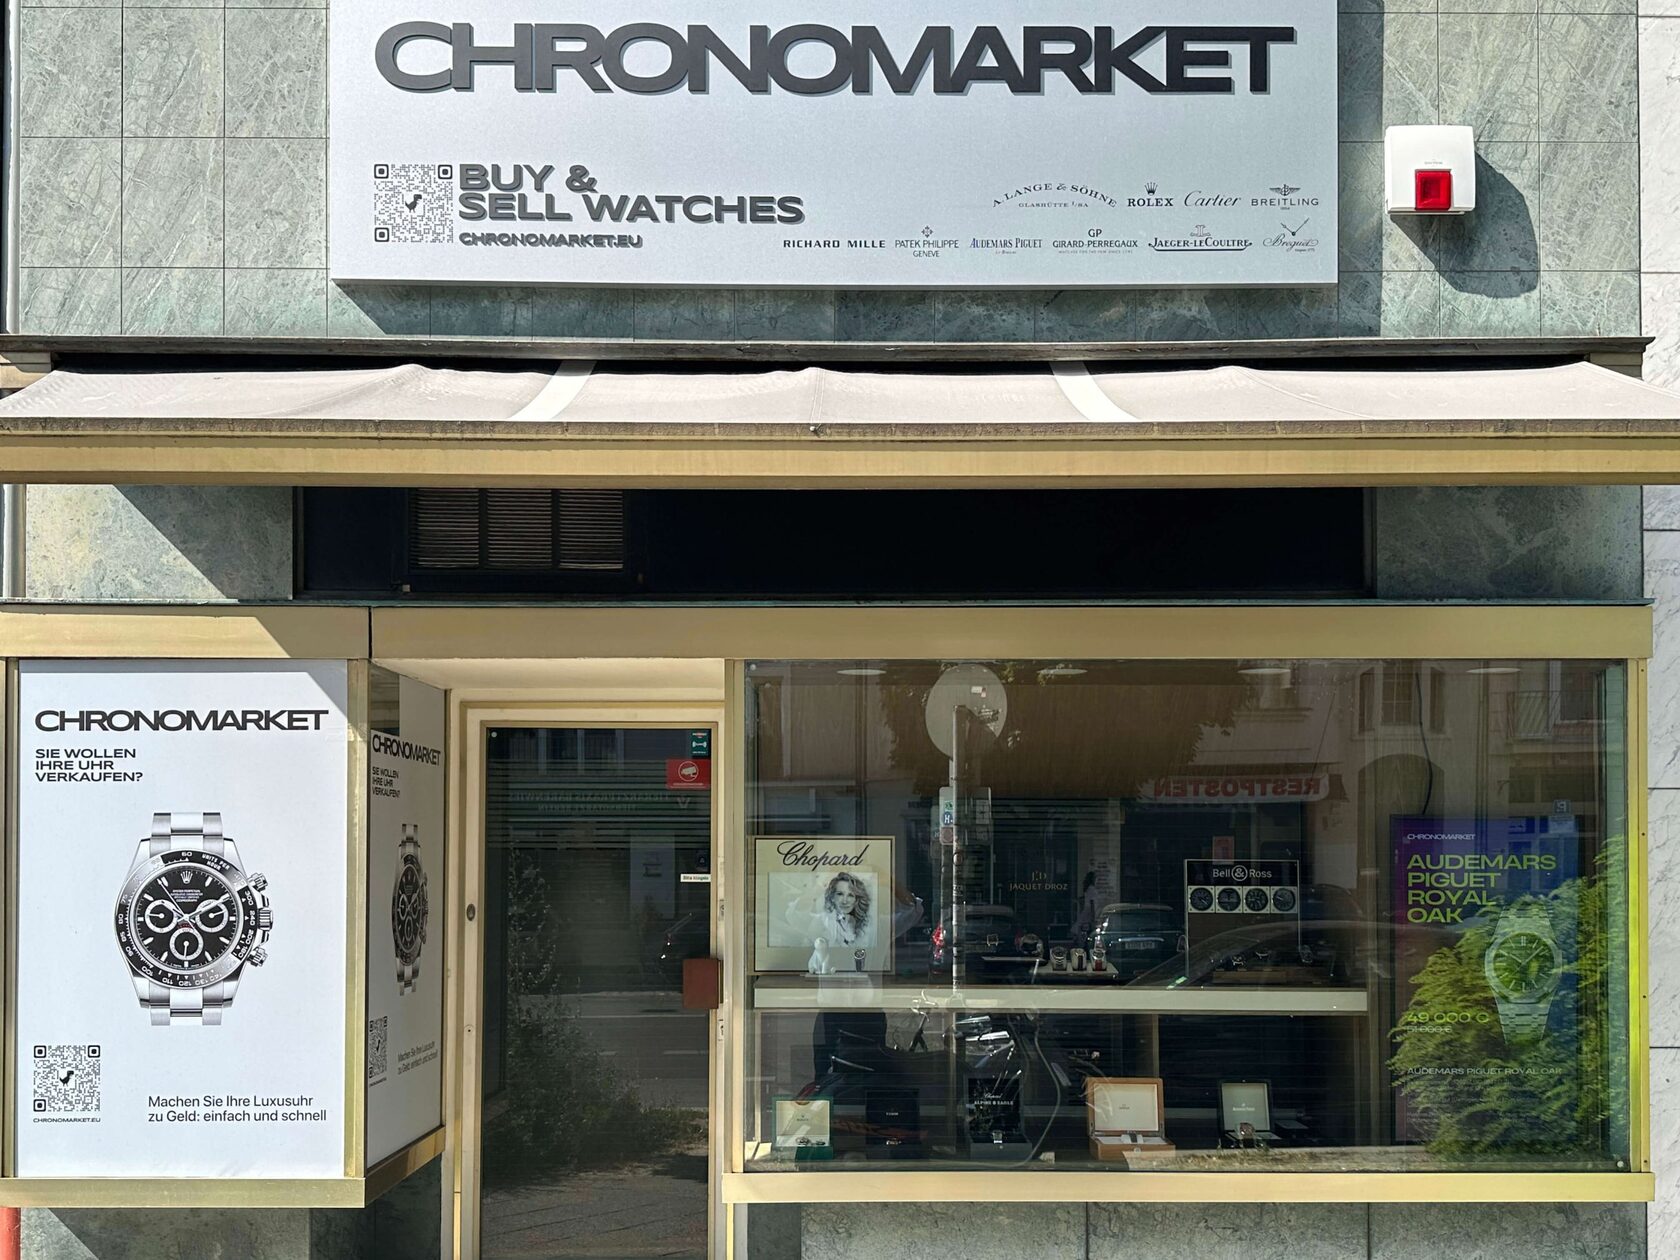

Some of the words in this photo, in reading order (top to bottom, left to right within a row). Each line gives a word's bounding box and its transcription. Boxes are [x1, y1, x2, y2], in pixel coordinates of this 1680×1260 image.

[375, 21, 1296, 94] CHRONOMARKET
[459, 163, 555, 192] BUY
[565, 164, 598, 193] &
[1004, 183, 1053, 200] LANGE
[1057, 183, 1067, 191] &
[1070, 184, 1117, 208] SÖHNE
[1127, 198, 1174, 207] ROLEX
[1184, 190, 1242, 207] Cartier
[1251, 198, 1320, 207] BREITLING
[459, 193, 573, 222] SELL
[582, 194, 806, 224] WATCHES
[459, 233, 643, 248] CHRONOMARKET.EU
[1088, 229, 1103, 238] GP
[783, 240, 840, 248] RICHARD
[848, 240, 886, 248] MILLE
[895, 240, 921, 248] PATEK
[923, 240, 959, 248] PHILIPPE
[970, 238, 1013, 249] AUDEMARS
[1015, 238, 1043, 249] PIGUET
[1053, 240, 1138, 248] GIRARD-PERREGAUX
[1263, 233, 1319, 252] Breguet
[35, 710, 329, 732] CHRONOMARKET
[36, 748, 60, 759] SIE
[64, 748, 137, 759] WOLLEN
[372, 734, 441, 766] CHRONOMARKET
[36, 760, 74, 770] IHRE
[78, 760, 115, 770] UHR
[35, 772, 144, 783] VERKAUFEN?
[777, 841, 870, 871] Chopard
[1407, 854, 1557, 870] AUDEMARS
[1213, 869, 1231, 878] Bell
[1249, 869, 1272, 879] Ross
[1407, 872, 1502, 888] PIGUET
[1407, 890, 1497, 906] ROYAL
[1407, 908, 1464, 923] OAK
[246, 929, 254, 945] 200
[1407, 1012, 1429, 1023] 49
[1434, 1012, 1471, 1023] 000
[148, 1096, 200, 1107] Machen
[203, 1096, 223, 1107] Sie
[226, 1096, 251, 1107] Ihre
[254, 1096, 313, 1107] Luxusuhr
[148, 1113, 163, 1122] zu
[167, 1110, 200, 1122] Geld:
[203, 1110, 250, 1122] einfach
[254, 1110, 278, 1122] und
[281, 1110, 327, 1122] schnell
